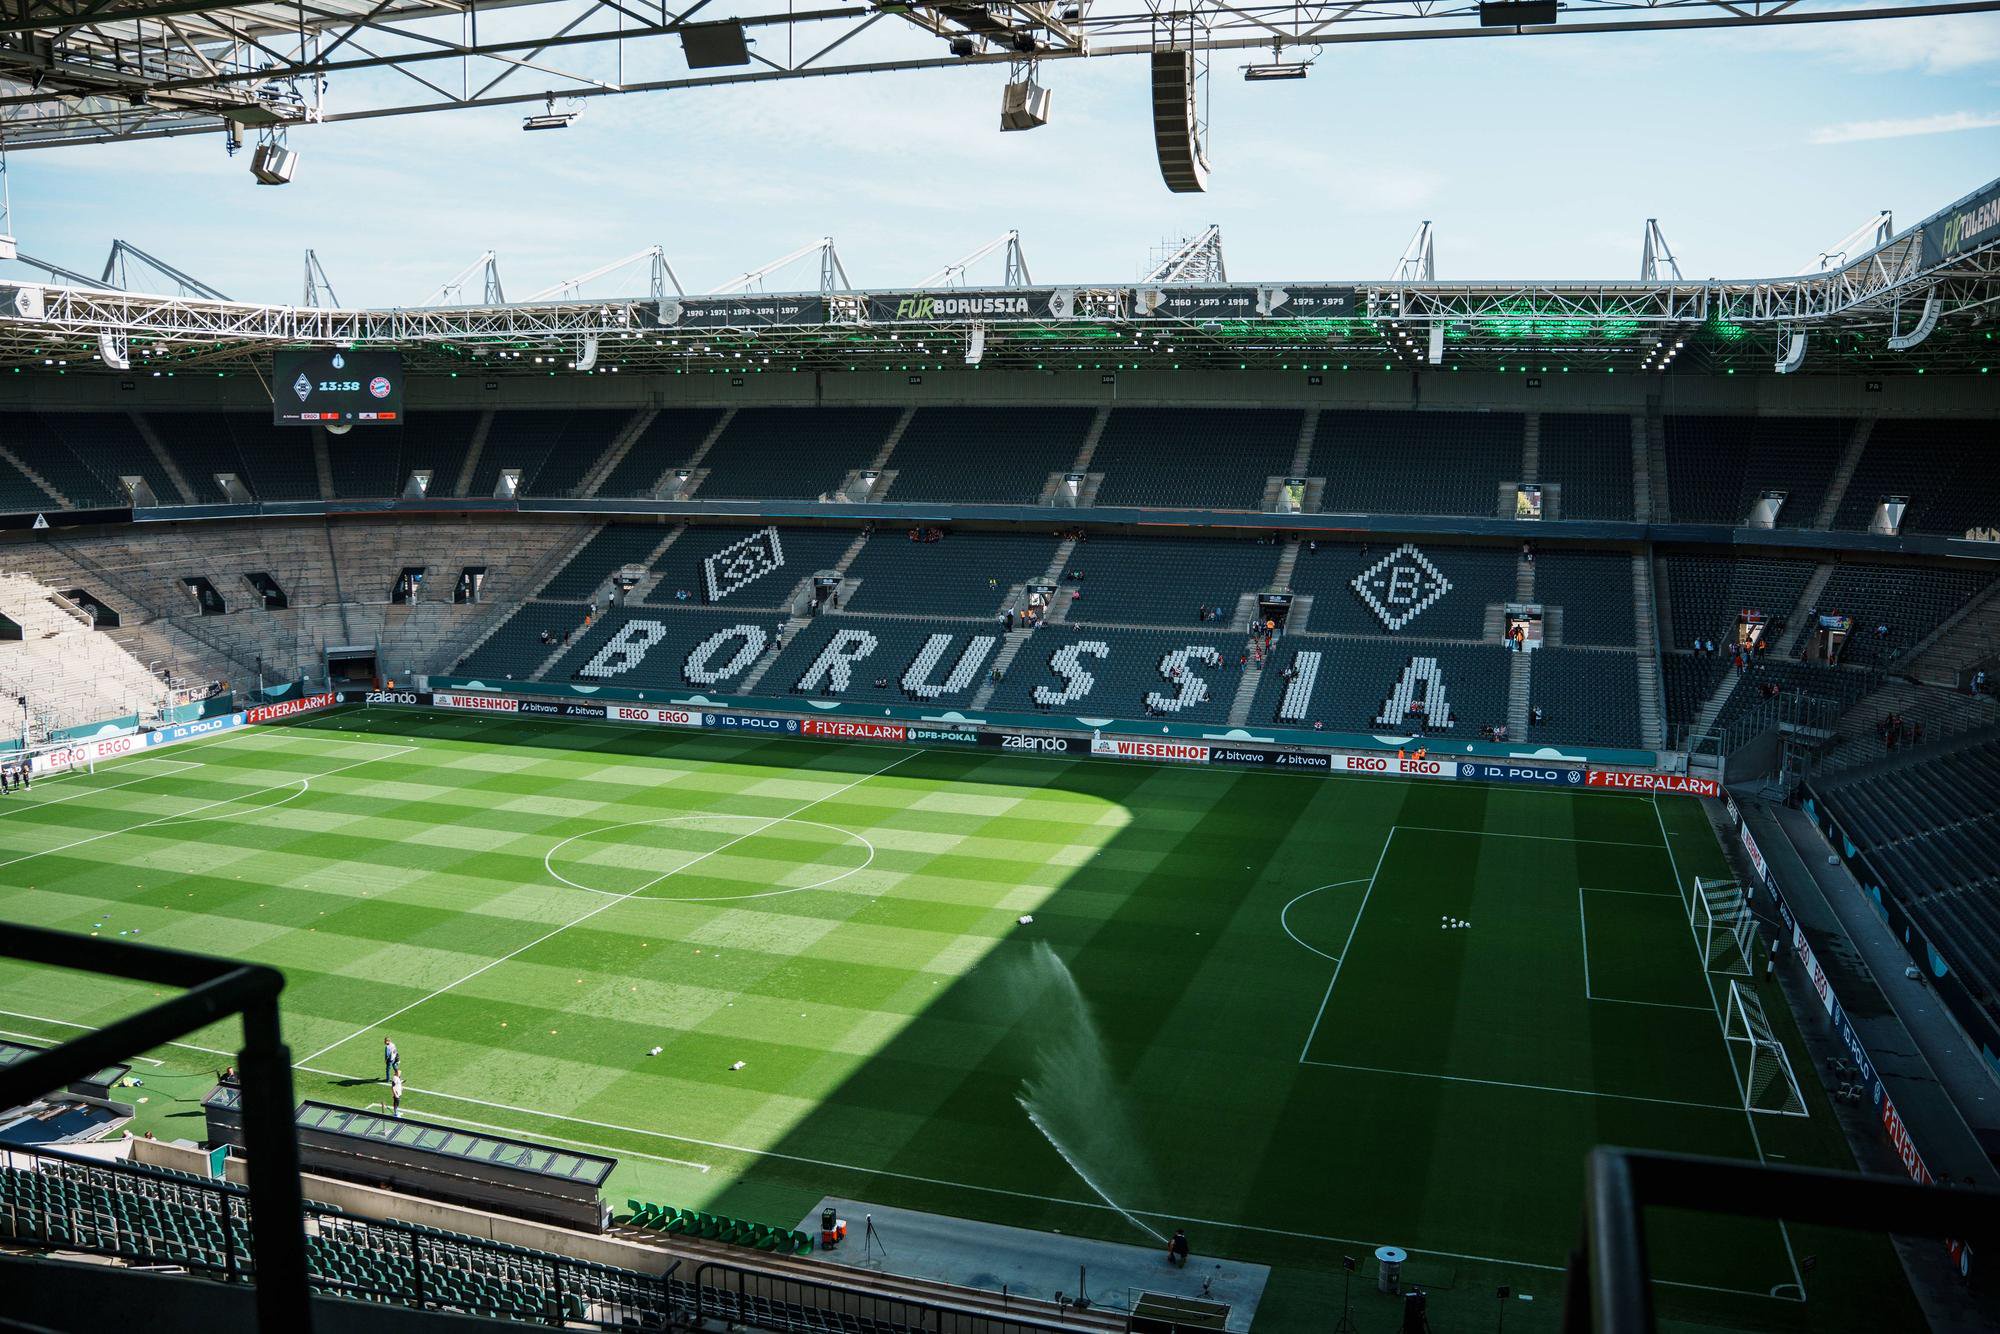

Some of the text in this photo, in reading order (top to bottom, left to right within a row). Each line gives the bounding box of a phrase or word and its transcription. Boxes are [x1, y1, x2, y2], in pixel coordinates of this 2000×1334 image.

[934, 298, 1028, 314] BORUSSIA
[1199, 298, 1220, 306] 1973
[1228, 298, 1249, 306] 1995
[1322, 297, 1344, 305] 1979
[319, 381, 360, 391] 13:38
[366, 691, 417, 705] zalando
[452, 696, 517, 711] WIESENHOF
[258, 696, 326, 720] FLYERALARM
[530, 703, 558, 713] bitvavo
[575, 706, 604, 716] bitvavo
[619, 708, 689, 723] ERGO ERGO
[722, 716, 738, 726] ID.
[742, 718, 780, 728] POLO
[191, 720, 222, 734] POLO
[815, 721, 904, 739] FLYERALARM
[917, 729, 977, 742] DFB-POKAL
[98, 738, 131, 756] ERGO
[1001, 735, 1067, 752] zalando
[1117, 741, 1209, 760] WIESENHOF
[1226, 751, 1264, 764] bitvavo
[1288, 755, 1327, 767] bitvavo
[1346, 756, 1441, 774] ERGO ERGO
[1484, 767, 1504, 777] ID.
[1509, 769, 1558, 780] POLO
[1605, 772, 1714, 795] FLYERALARM
[1851, 1039, 1870, 1081] POLO
